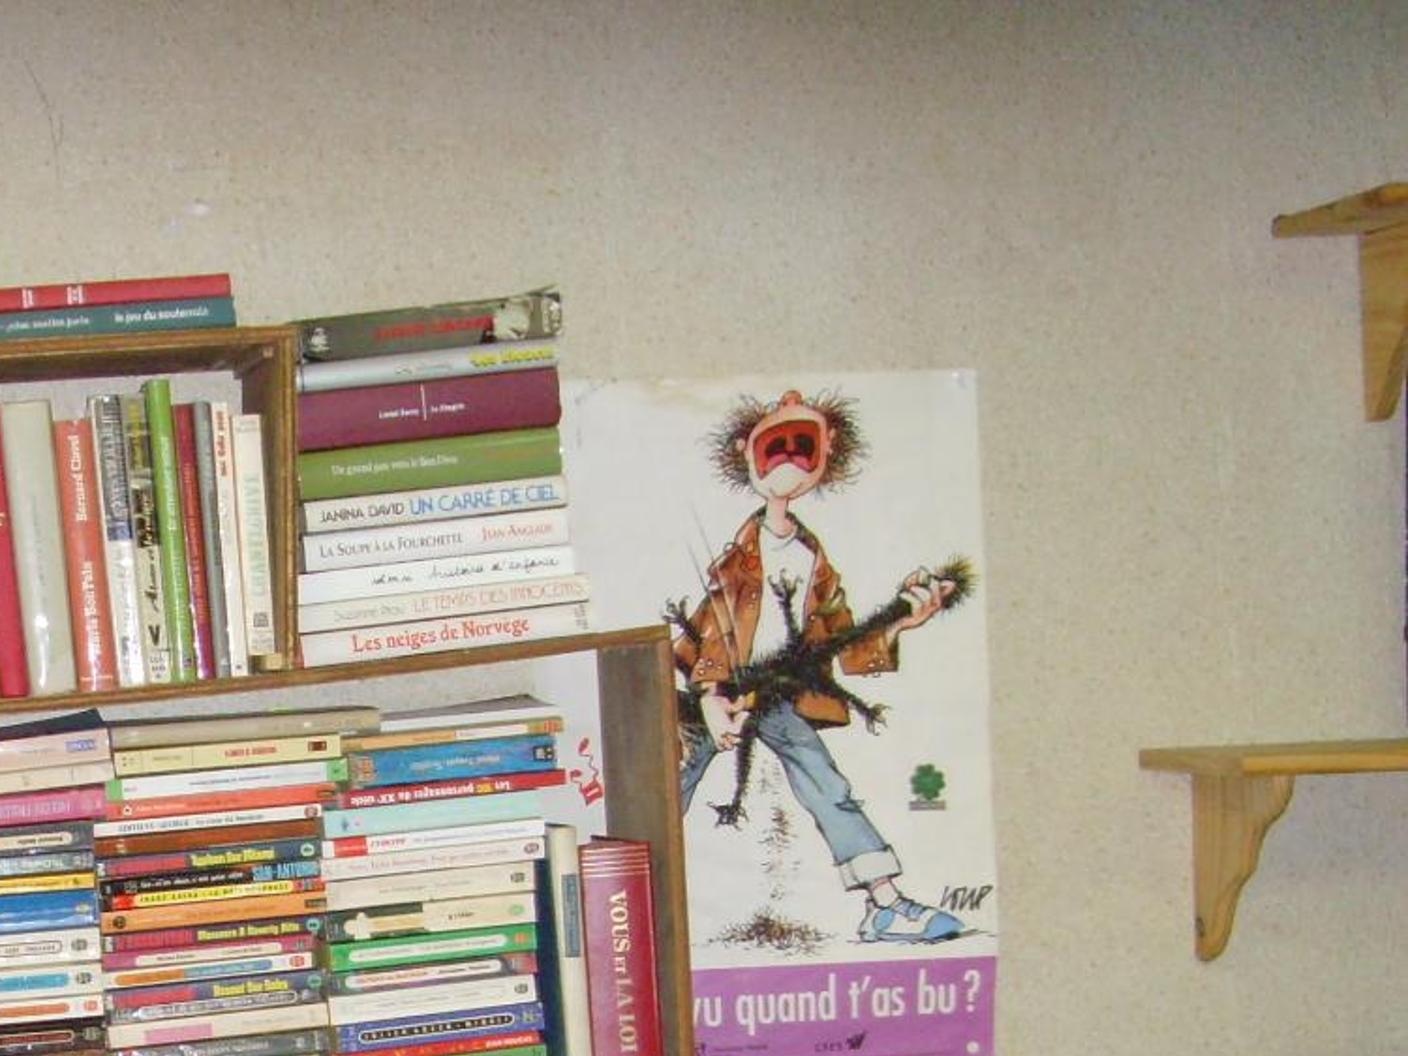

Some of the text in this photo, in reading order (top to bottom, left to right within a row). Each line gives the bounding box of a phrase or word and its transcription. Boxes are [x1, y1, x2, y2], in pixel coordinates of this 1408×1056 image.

[320, 506, 365, 523] JANINA
[368, 501, 404, 519] DAVID
[410, 499, 434, 516] UN
[438, 488, 496, 511] CARRÉ
[500, 487, 522, 505] DE
[352, 617, 530, 652] Les neiges de Norvège
[609, 890, 631, 953] VOUS
[616, 977, 635, 1008] LA
[736, 972, 837, 1037] quand
[848, 975, 905, 1019] t'as
[918, 968, 957, 1015] bu
[964, 968, 981, 1013] ?
[618, 1014, 639, 1052] LOI
